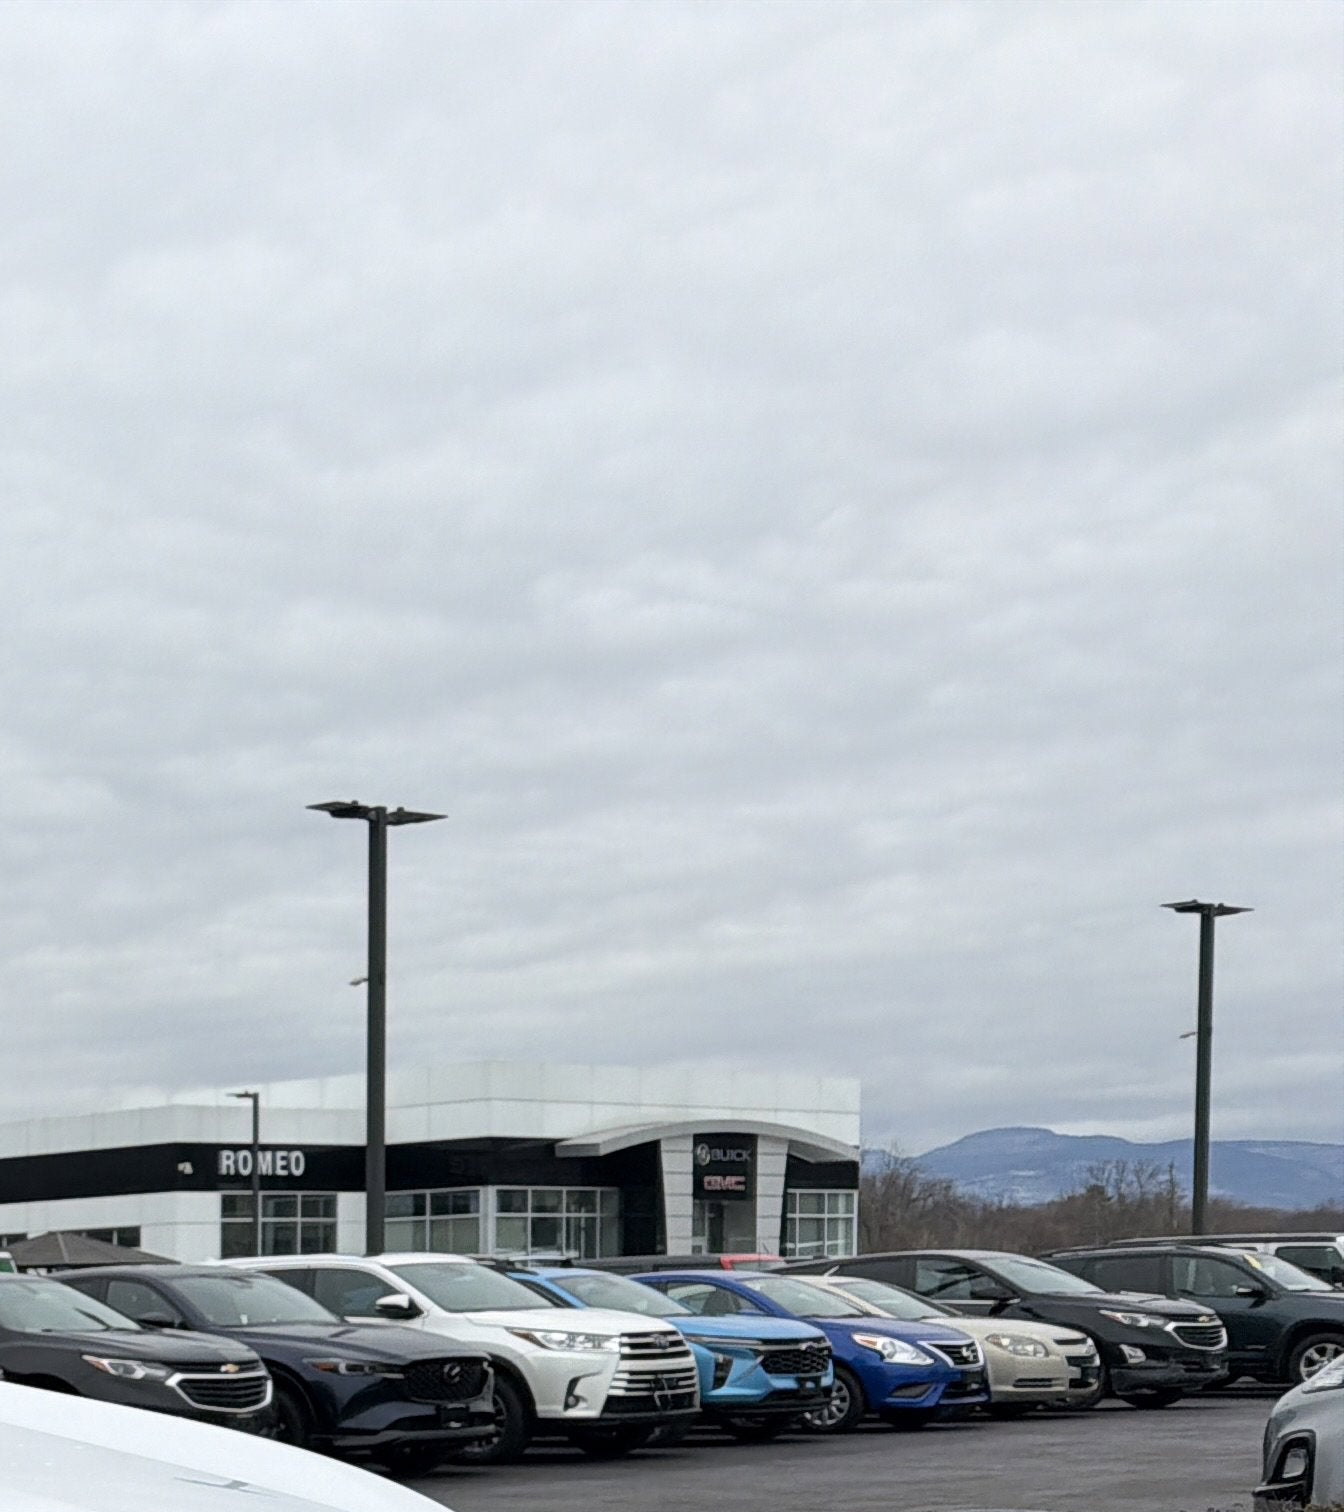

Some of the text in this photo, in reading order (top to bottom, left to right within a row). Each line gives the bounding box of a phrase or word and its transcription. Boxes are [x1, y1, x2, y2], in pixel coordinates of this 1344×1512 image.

[218, 1149, 305, 1176] ROMEO
[712, 1149, 751, 1161] BUICK
[704, 1175, 745, 1191] GMC
